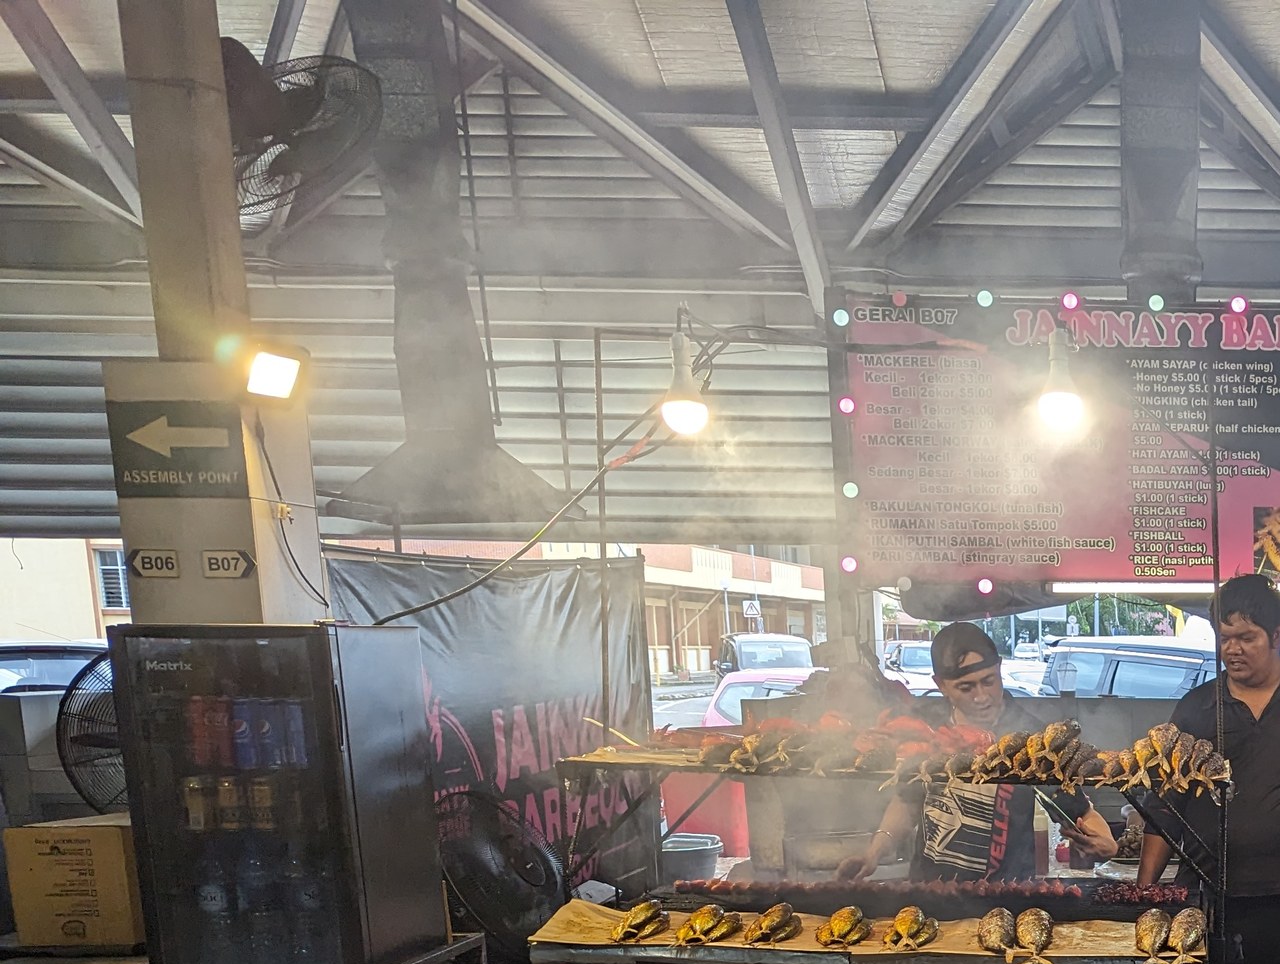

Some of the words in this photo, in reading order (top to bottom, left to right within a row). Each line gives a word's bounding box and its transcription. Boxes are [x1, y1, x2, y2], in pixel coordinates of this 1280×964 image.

[854, 308, 914, 323] GERAI
[920, 309, 958, 324] B07
[1162, 360, 1197, 370] SAYAP
[1245, 362, 1274, 372] wing)
[864, 371, 898, 384] Kecil
[1171, 373, 1199, 383] $5.00
[1215, 374, 1241, 383] stick
[1249, 375, 1278, 385] 5pcs)
[1153, 384, 1185, 395] Honey
[1232, 386, 1257, 395] stick
[1237, 398, 1258, 409] tail)
[1177, 410, 1207, 421] stick)
[1215, 424, 1239, 434] (half
[1133, 436, 1162, 445] $5.00
[1160, 450, 1188, 459] AYAM
[1231, 451, 1261, 462] stick)
[123, 470, 193, 484] ASSEMBLY
[198, 471, 239, 483] POINT
[1170, 465, 1198, 475] AYAM
[1241, 466, 1271, 477] stick)
[1135, 494, 1163, 503] $1.00
[1178, 494, 1208, 505] stick)
[936, 502, 998, 514] TONGKOL
[1036, 503, 1065, 516] fish)
[939, 519, 968, 531] Satu
[969, 520, 1021, 534] Tompok
[1023, 520, 1058, 532] $5.00
[1134, 518, 1162, 528] $1.00
[1177, 519, 1207, 530] stick)
[907, 535, 947, 548] PUTIH
[949, 535, 1004, 549] SAMBAL
[1006, 536, 1044, 550] (white
[1047, 536, 1071, 549] fish
[1073, 538, 1116, 551] sauce)
[1134, 543, 1163, 553] $1.00
[1177, 543, 1208, 554] stick)
[141, 556, 175, 571] B06
[207, 556, 240, 571] B07
[906, 552, 958, 563] SAMBAL
[961, 552, 1016, 566] (stingray
[1019, 553, 1062, 566] sauce)
[1161, 555, 1186, 567] (nasi
[1135, 567, 1176, 577] 0.50Sen
[145, 660, 194, 671] Matrix
